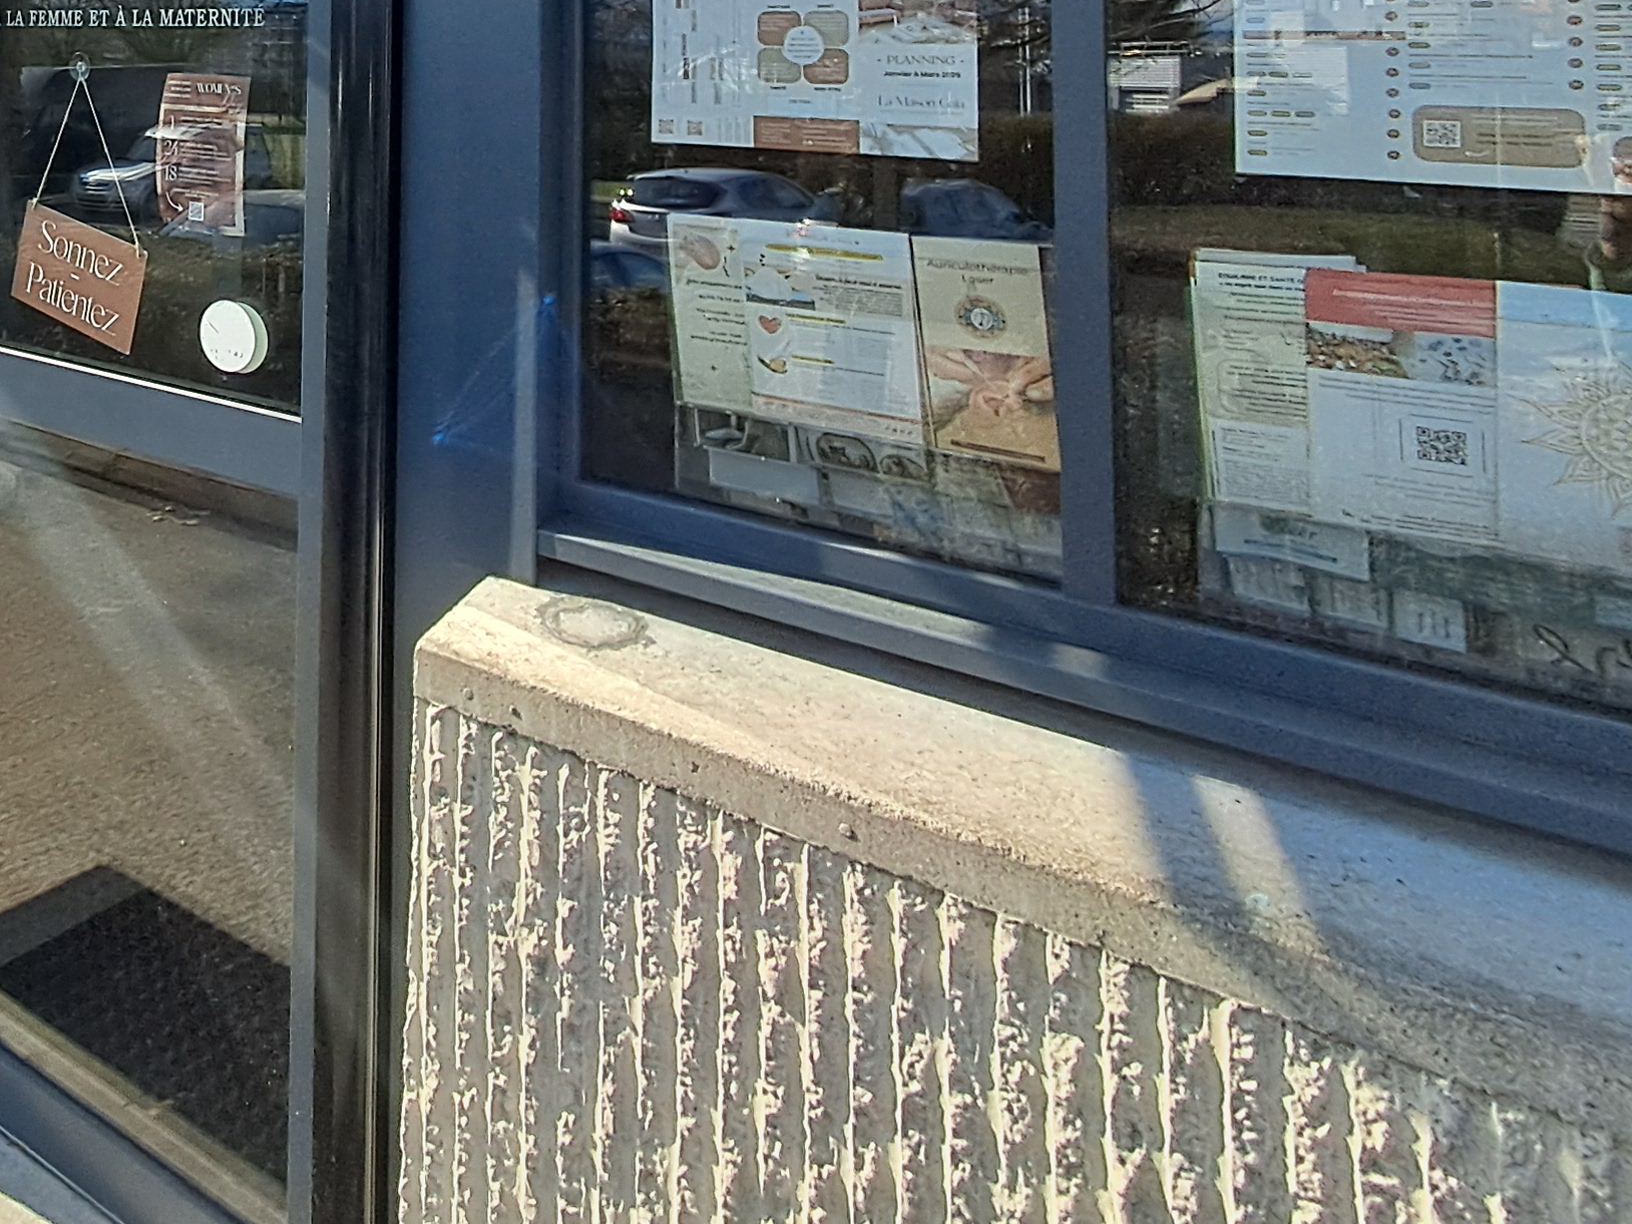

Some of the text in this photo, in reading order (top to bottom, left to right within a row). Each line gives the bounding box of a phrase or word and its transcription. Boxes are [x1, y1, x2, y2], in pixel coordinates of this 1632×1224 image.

[6, 9, 25, 27] LA
[28, 9, 84, 27] FEMME
[88, 8, 110, 27] ET
[114, 4, 127, 27] À
[131, 8, 154, 27] LA
[158, 3, 266, 27] MATERNITÉ
[886, 55, 956, 65] PLANNING
[38, 220, 124, 286] Sonnez
[26, 261, 120, 337] Patientez
